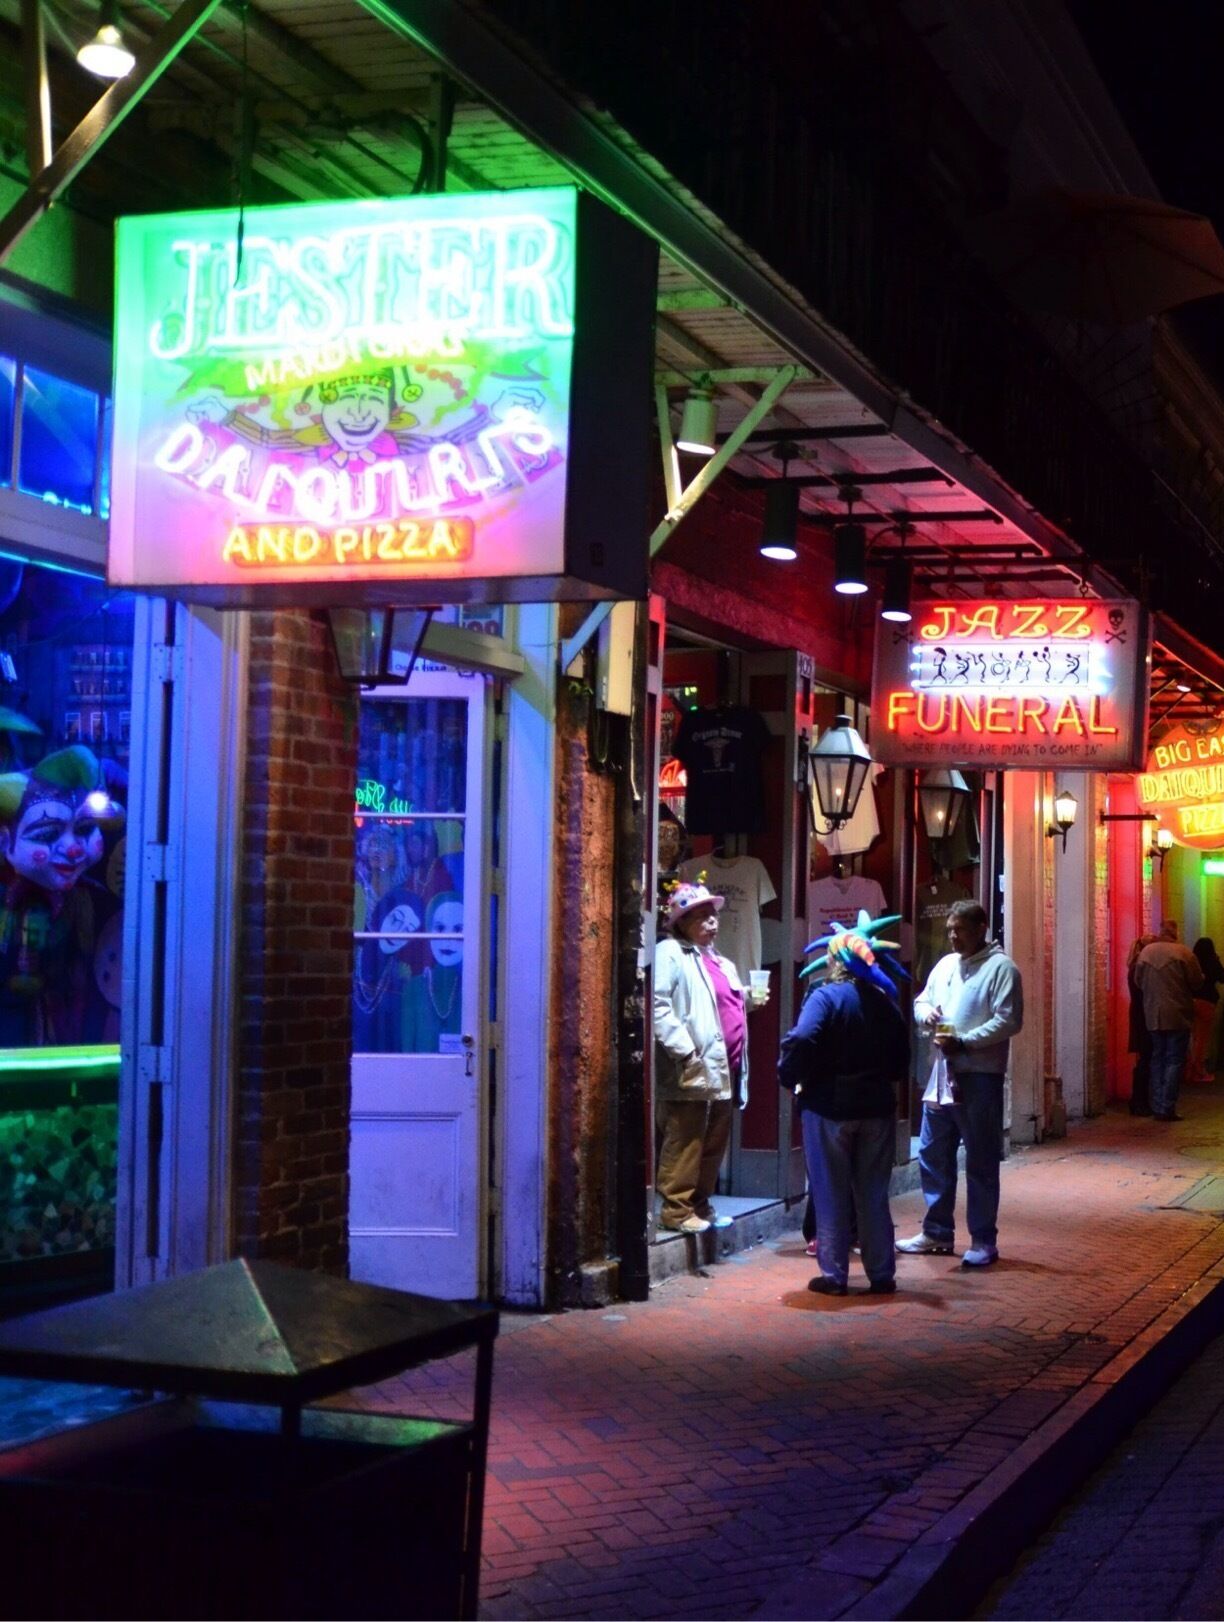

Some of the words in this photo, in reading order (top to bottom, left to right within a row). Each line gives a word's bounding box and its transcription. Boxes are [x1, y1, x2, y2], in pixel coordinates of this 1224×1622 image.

[149, 213, 577, 360] JESTER
[244, 338, 364, 391] MARDI
[222, 525, 320, 563] AND
[333, 522, 460, 562] PIZZA
[920, 604, 1092, 640] JAZZ
[887, 692, 1118, 734] FUNERAL
[979, 743, 998, 755] ARE
[1001, 743, 1030, 756] DYING
[1033, 743, 1046, 755] TO
[1050, 744, 1081, 756] COME
[1154, 741, 1191, 768] BIG
